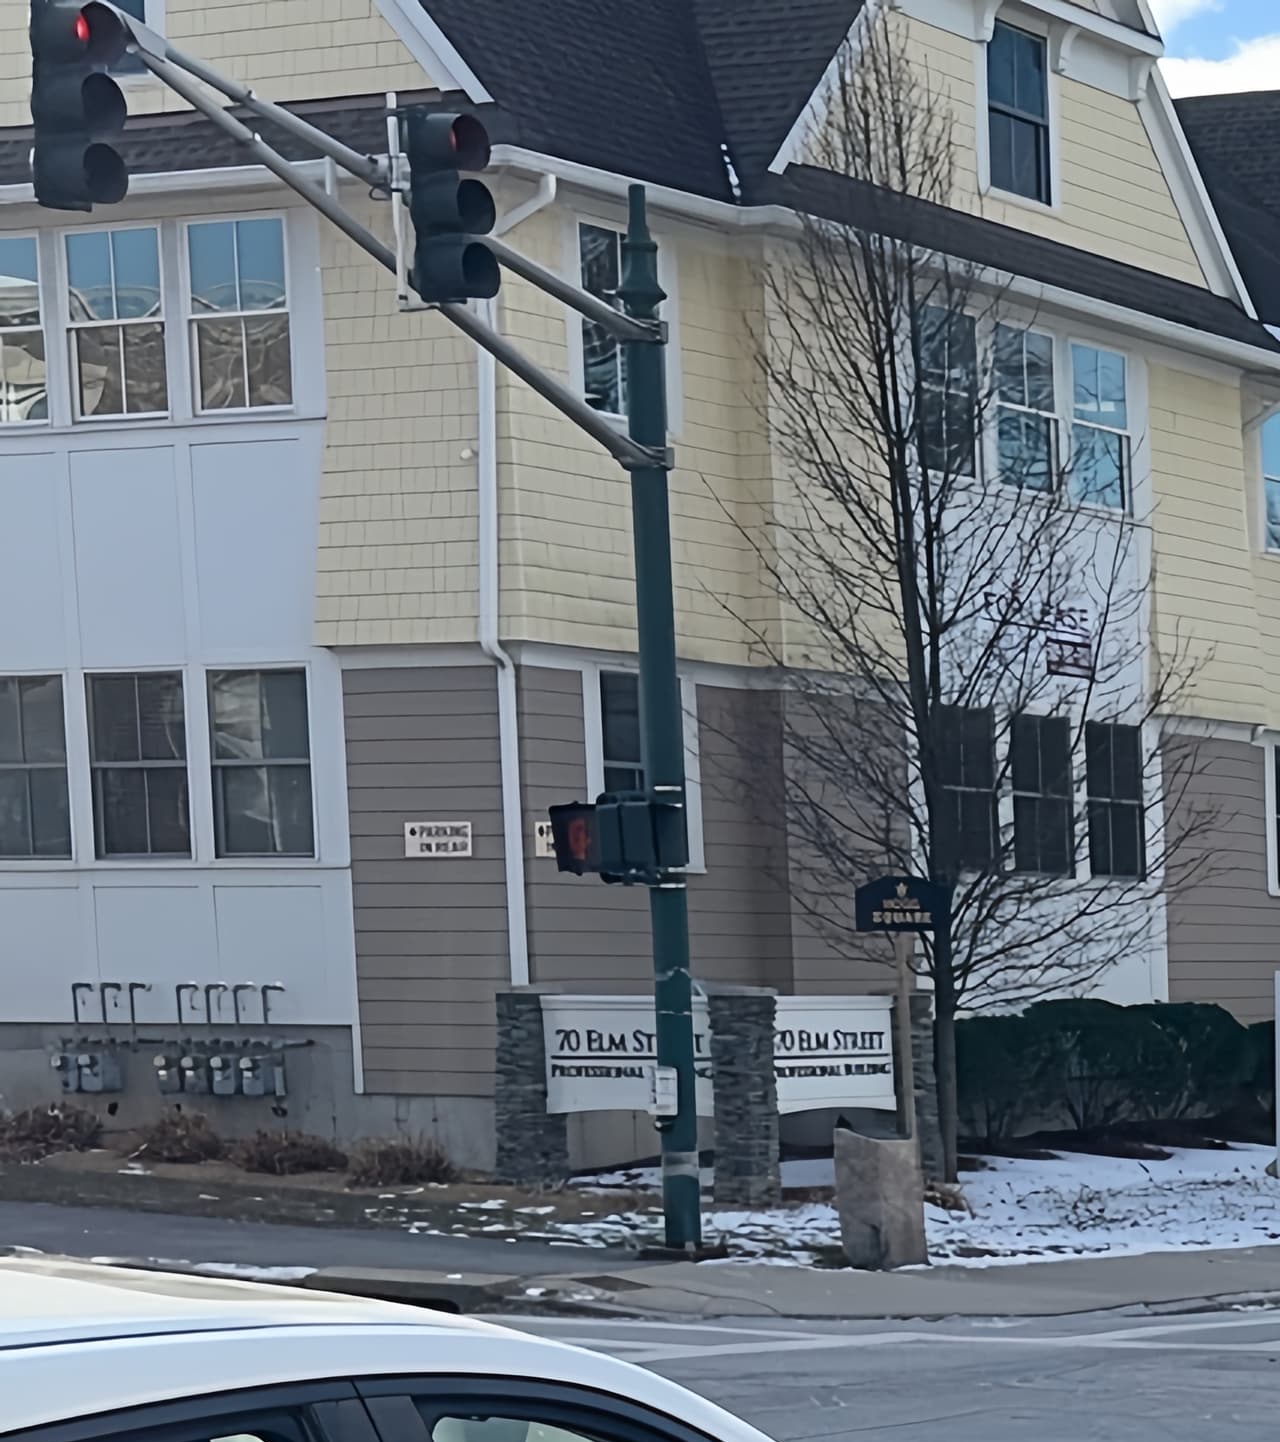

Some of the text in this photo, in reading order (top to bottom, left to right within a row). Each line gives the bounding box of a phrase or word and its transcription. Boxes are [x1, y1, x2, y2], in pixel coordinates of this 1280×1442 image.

[872, 911, 932, 924] SQUARE
[555, 1029, 580, 1051] 70
[586, 1029, 628, 1052] ELM
[798, 1029, 829, 1051] ELM
[833, 1029, 885, 1050] STREET
